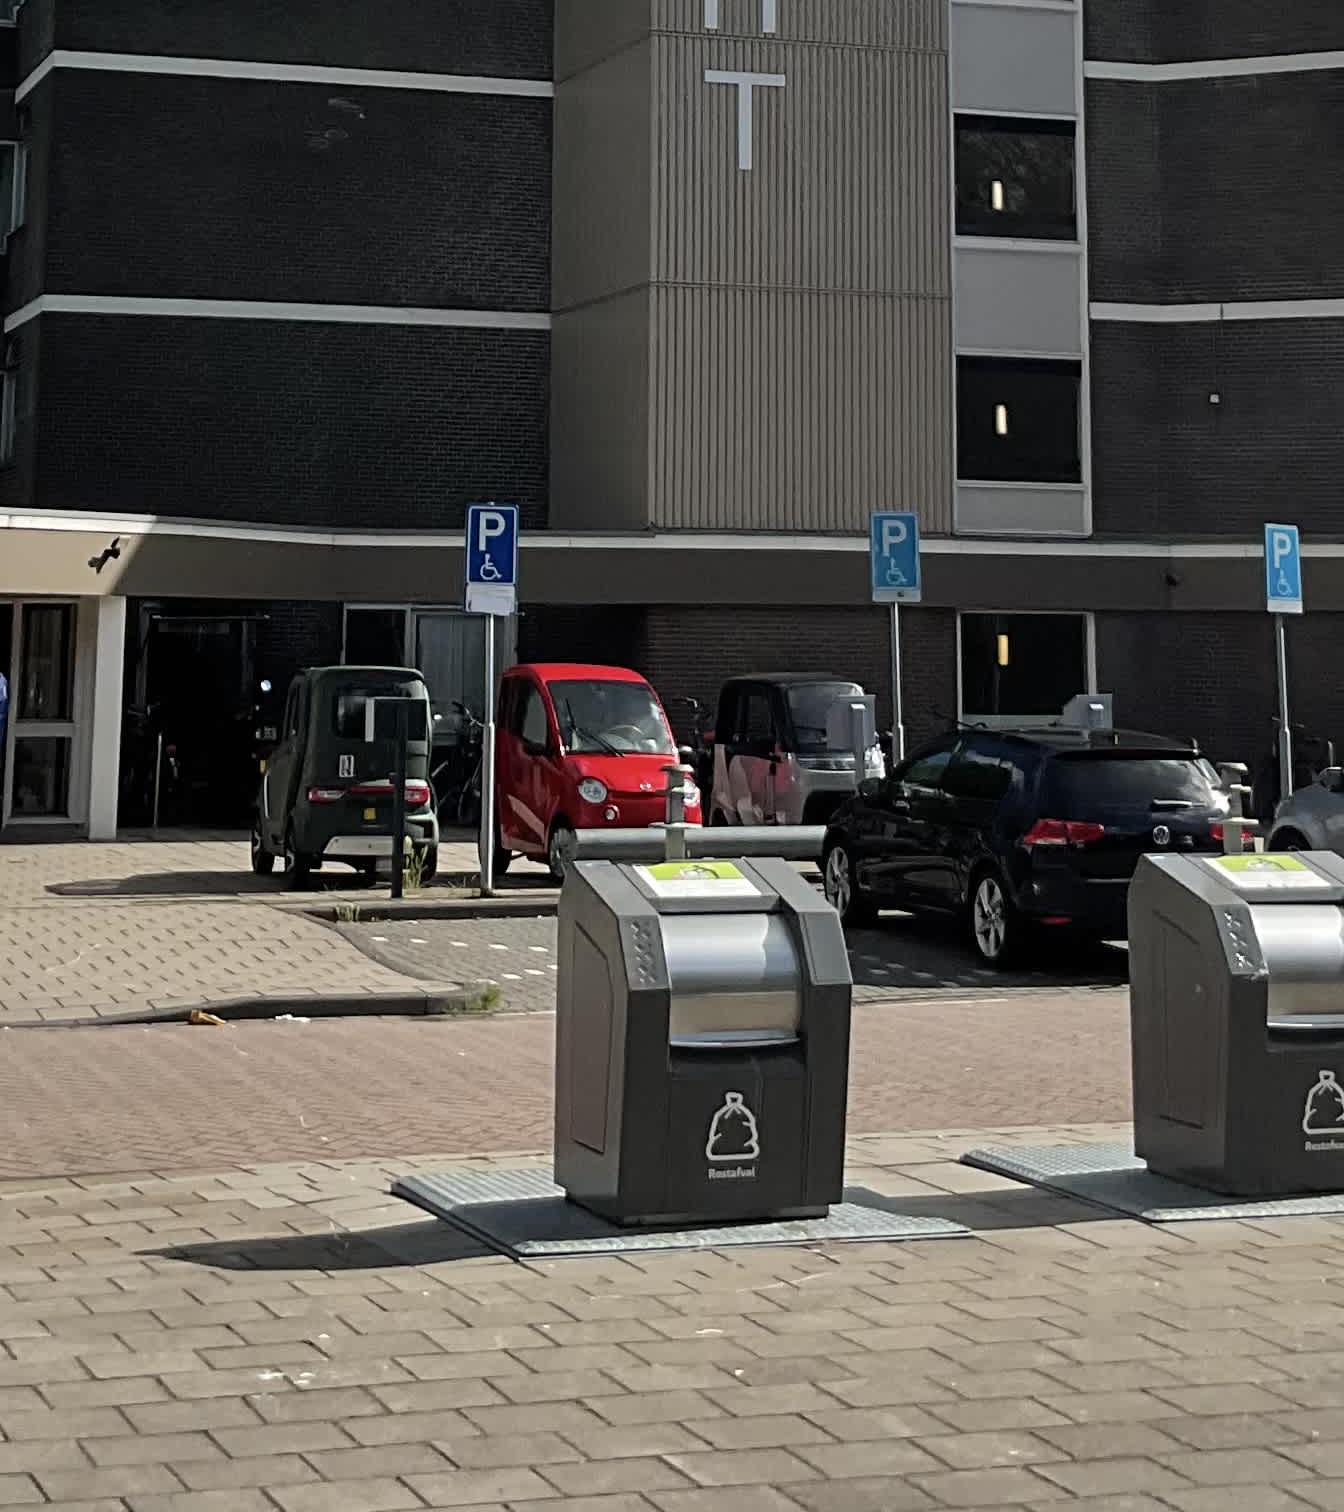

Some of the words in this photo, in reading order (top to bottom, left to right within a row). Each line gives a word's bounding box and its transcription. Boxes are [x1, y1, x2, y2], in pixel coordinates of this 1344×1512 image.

[479, 511, 506, 552] P
[882, 520, 907, 557] P
[1273, 531, 1292, 568] P
[708, 1165, 756, 1179] Restafval
